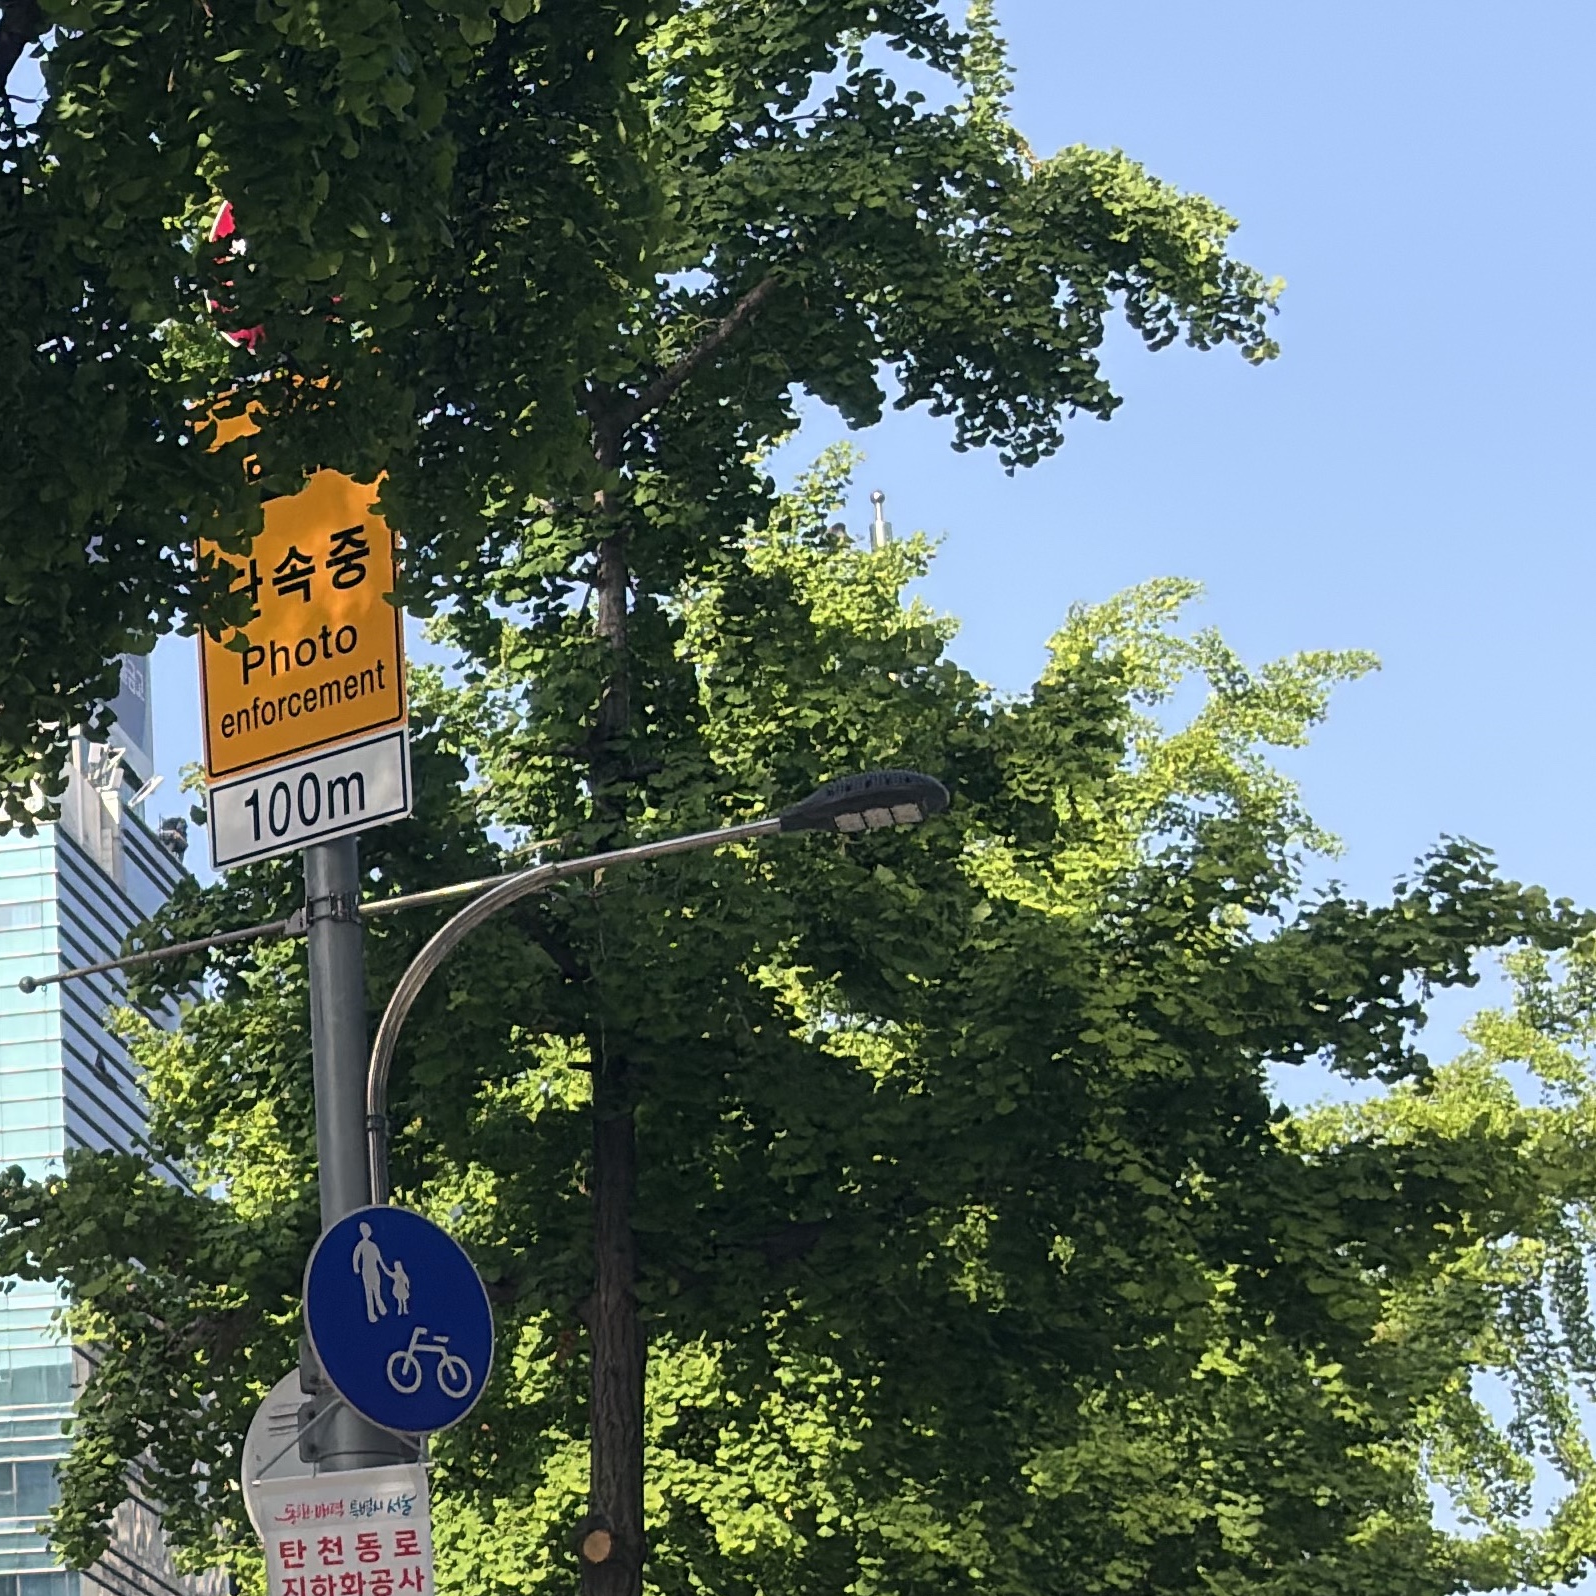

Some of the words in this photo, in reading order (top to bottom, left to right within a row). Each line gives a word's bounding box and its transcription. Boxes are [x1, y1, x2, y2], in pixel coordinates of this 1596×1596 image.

[241, 624, 358, 685] Photo
[220, 660, 386, 739] enforcement
[244, 769, 366, 842] 100m
[279, 1529, 422, 1571] 탄천동로
